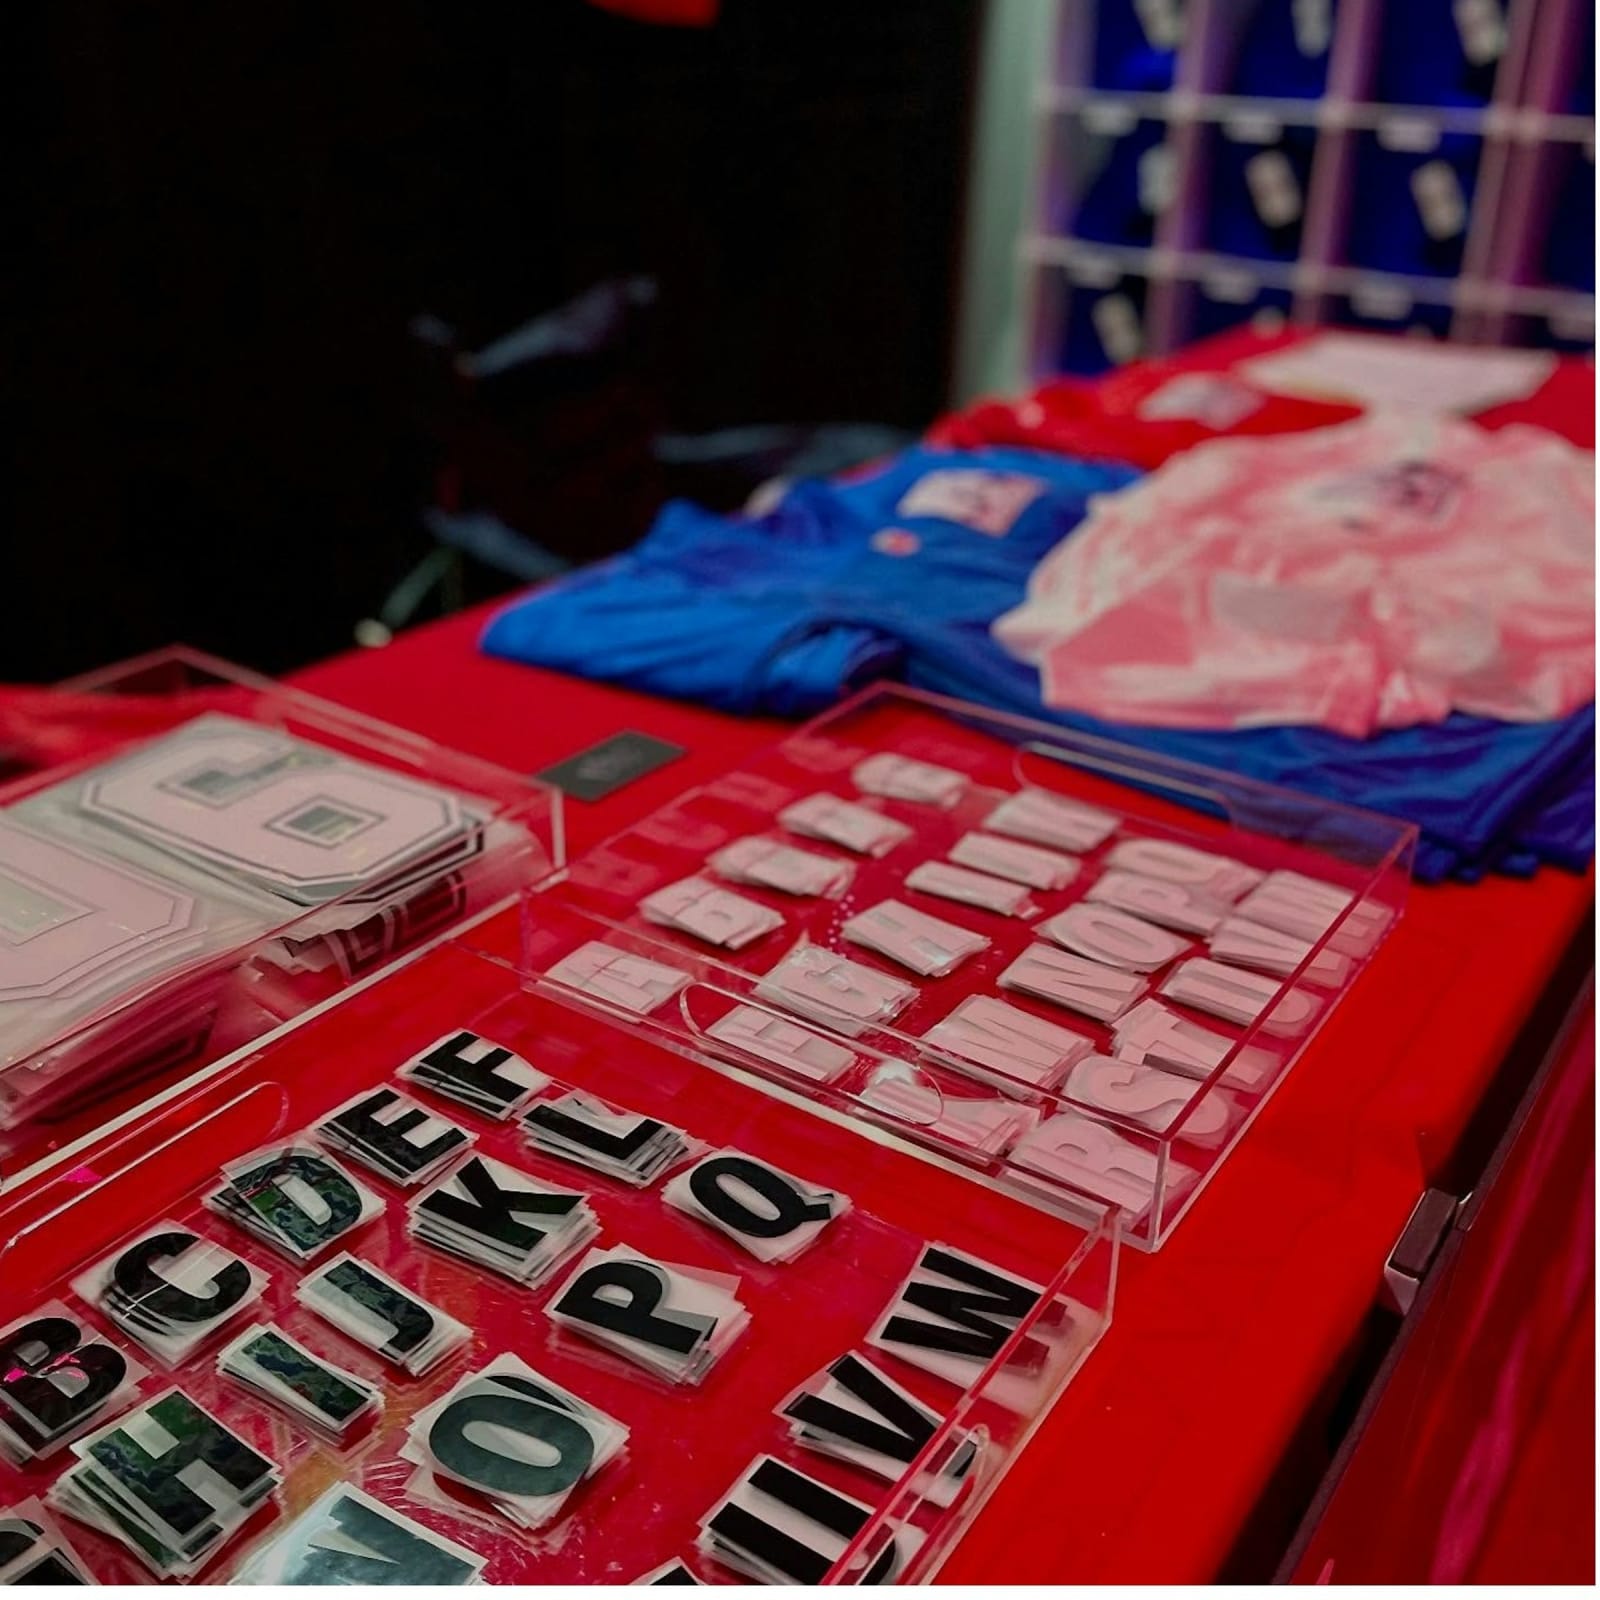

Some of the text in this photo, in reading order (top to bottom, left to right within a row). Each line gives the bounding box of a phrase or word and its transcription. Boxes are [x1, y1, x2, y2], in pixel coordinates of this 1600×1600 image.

[82, 727, 461, 887] 6
[844, 900, 985, 975] H
[1000, 943, 1143, 1018] N
[1068, 905, 1180, 966] O
[419, 1032, 528, 1103] F
[938, 997, 1082, 1084] M
[331, 1088, 470, 1172] E
[524, 1103, 665, 1160] L
[229, 1154, 363, 1252] D
[414, 1155, 587, 1251] K
[690, 1157, 832, 1239] Q
[114, 1232, 252, 1323] C
[324, 1259, 435, 1354] J
[553, 1259, 706, 1355] P
[880, 1247, 1068, 1370] W
[0, 1317, 128, 1434] B
[783, 1354, 977, 1478] V
[87, 1391, 274, 1537] H
[429, 1394, 596, 1497] O
[708, 1458, 898, 1585] U
